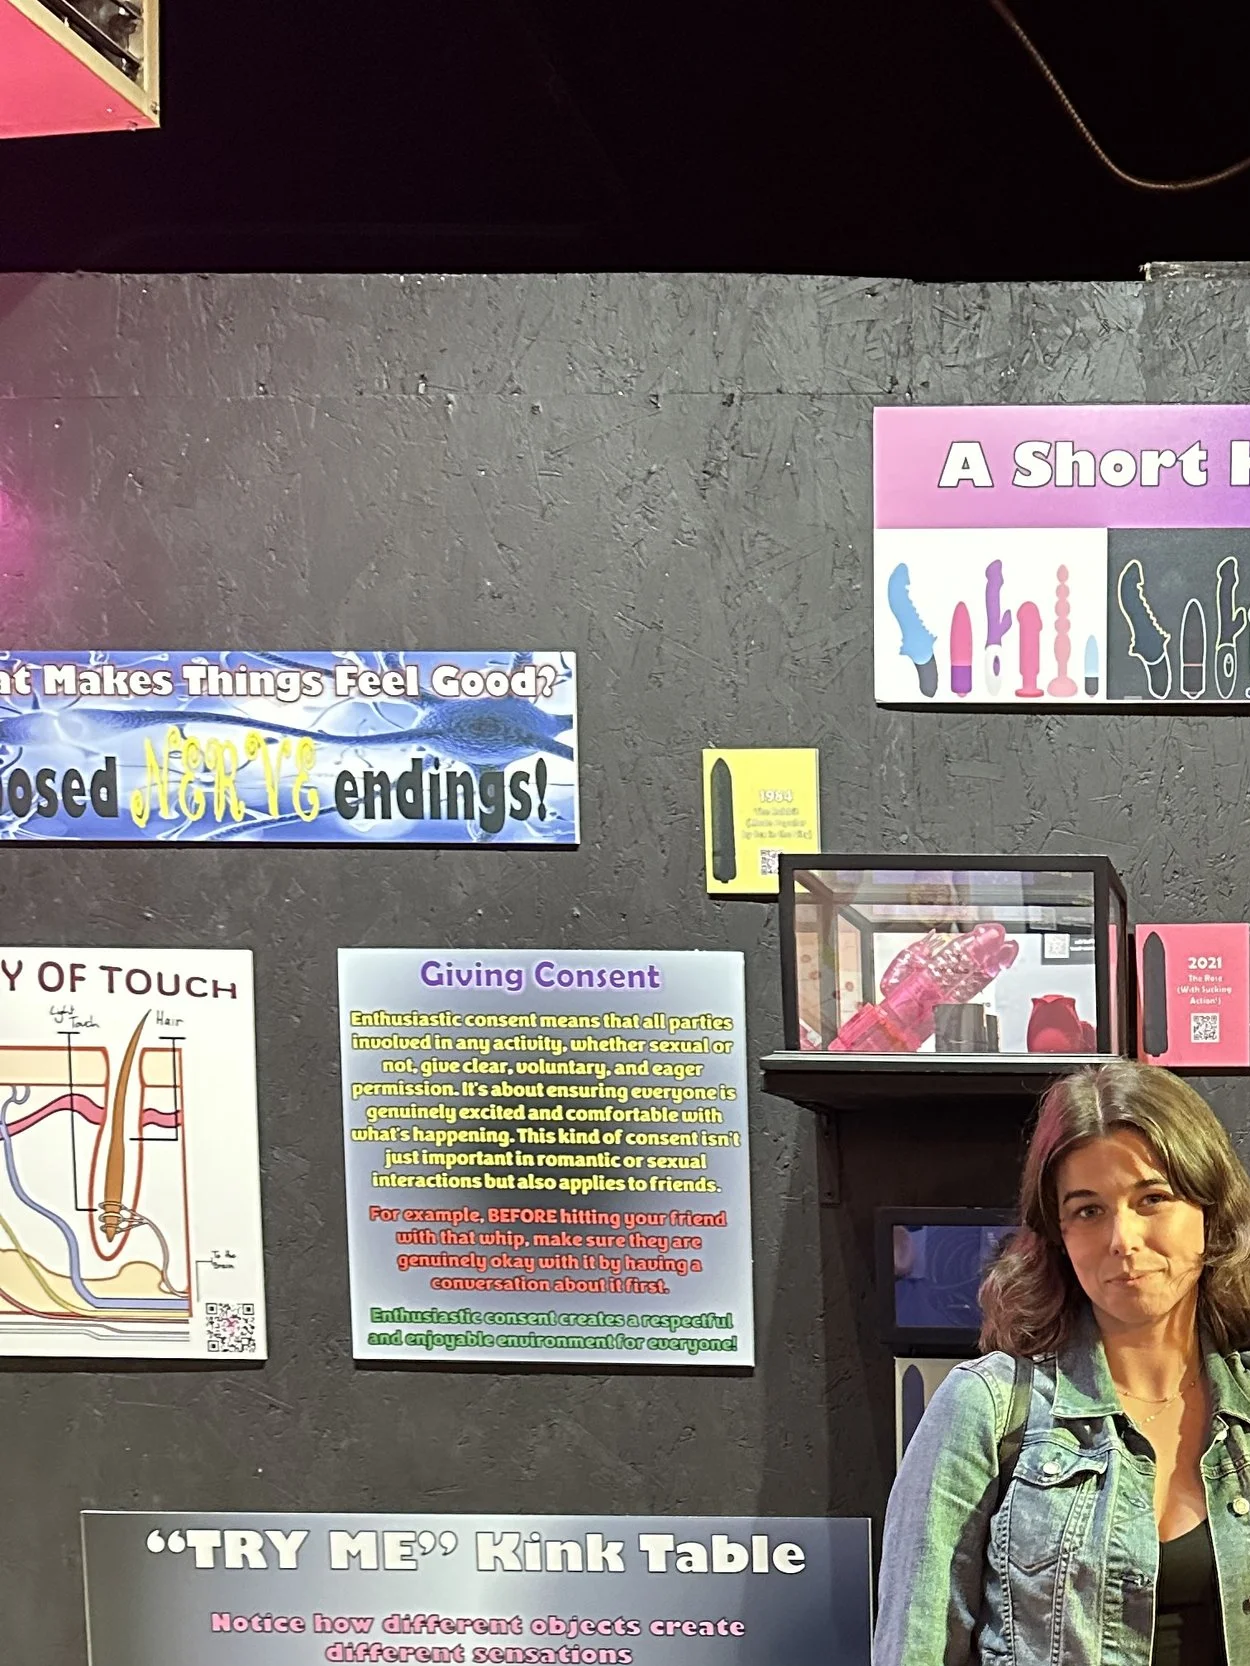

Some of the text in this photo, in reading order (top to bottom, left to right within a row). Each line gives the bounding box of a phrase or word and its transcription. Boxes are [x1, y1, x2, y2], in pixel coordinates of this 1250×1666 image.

[937, 440, 995, 488] A
[1012, 439, 1208, 488] Short
[43, 663, 173, 697] Makes
[182, 664, 323, 702] Things
[334, 664, 419, 698] Feel
[431, 664, 557, 698] Good?
[0, 725, 548, 833] osed NERVE endings!
[759, 789, 793, 804] 1984
[1187, 956, 1222, 970] 2021
[38, 960, 87, 993] OF
[98, 964, 238, 999] TOUCH
[421, 961, 661, 991] Giving Consent
[1188, 974, 1203, 982] The
[156, 1009, 184, 1027] Hair
[351, 1011, 733, 1033] Enthusiastic consent means that all parties
[352, 1035, 733, 1055] involved in any activity, whether sexual or
[382, 1060, 703, 1080] not, give clear, voluntary, and eager
[352, 1082, 736, 1103] permission. It's about ensuring everyone is
[366, 1104, 722, 1123] genuinely excited and comfortable with
[352, 1127, 740, 1147] what's happening. This kind of consent isn't
[384, 1150, 707, 1170] just important in romantic or sexual
[372, 1172, 722, 1194] interactions but also applies to friends.
[370, 1206, 727, 1229] For example, BEFORE hitting your friend
[396, 1229, 702, 1251] with that whip, make sure they are
[397, 1253, 702, 1275] genuinely okay with it by having a
[431, 1277, 670, 1294] conversation about it first.
[371, 1308, 733, 1331] Enthusiastic consent creates a respectful
[368, 1330, 737, 1354] and enjoyable environment for everyone!
[475, 1531, 626, 1573] Kink
[638, 1533, 806, 1575] Table
[210, 1611, 746, 1639] Notice how different objects create
[325, 1642, 633, 1665] different sensations
